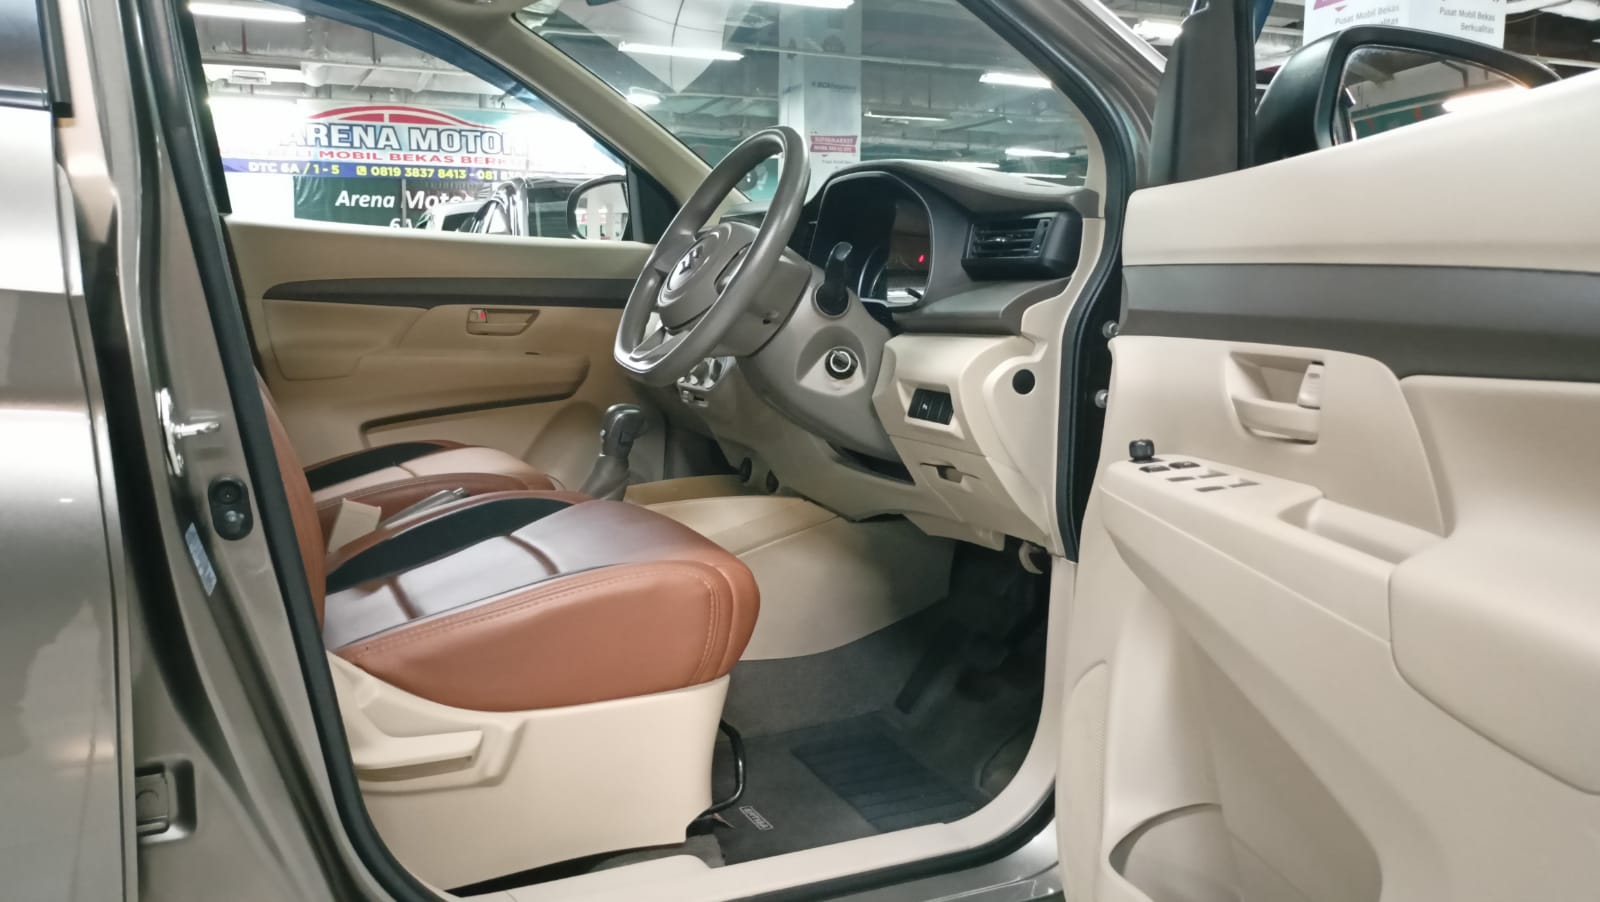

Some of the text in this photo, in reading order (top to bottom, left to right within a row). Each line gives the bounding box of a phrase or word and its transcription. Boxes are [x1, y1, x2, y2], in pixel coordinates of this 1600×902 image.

[1440, 7, 1495, 21] Pusat Mobil Bekas
[1460, 22, 1495, 34] Berkualitas
[319, 151, 382, 161] MOBIL
[390, 153, 454, 163] BEKAS
[248, 161, 278, 173] DTC
[371, 167, 401, 177] 0819
[405, 167, 434, 178] 3837
[438, 168, 466, 179] 8413
[335, 190, 395, 208] Arena
